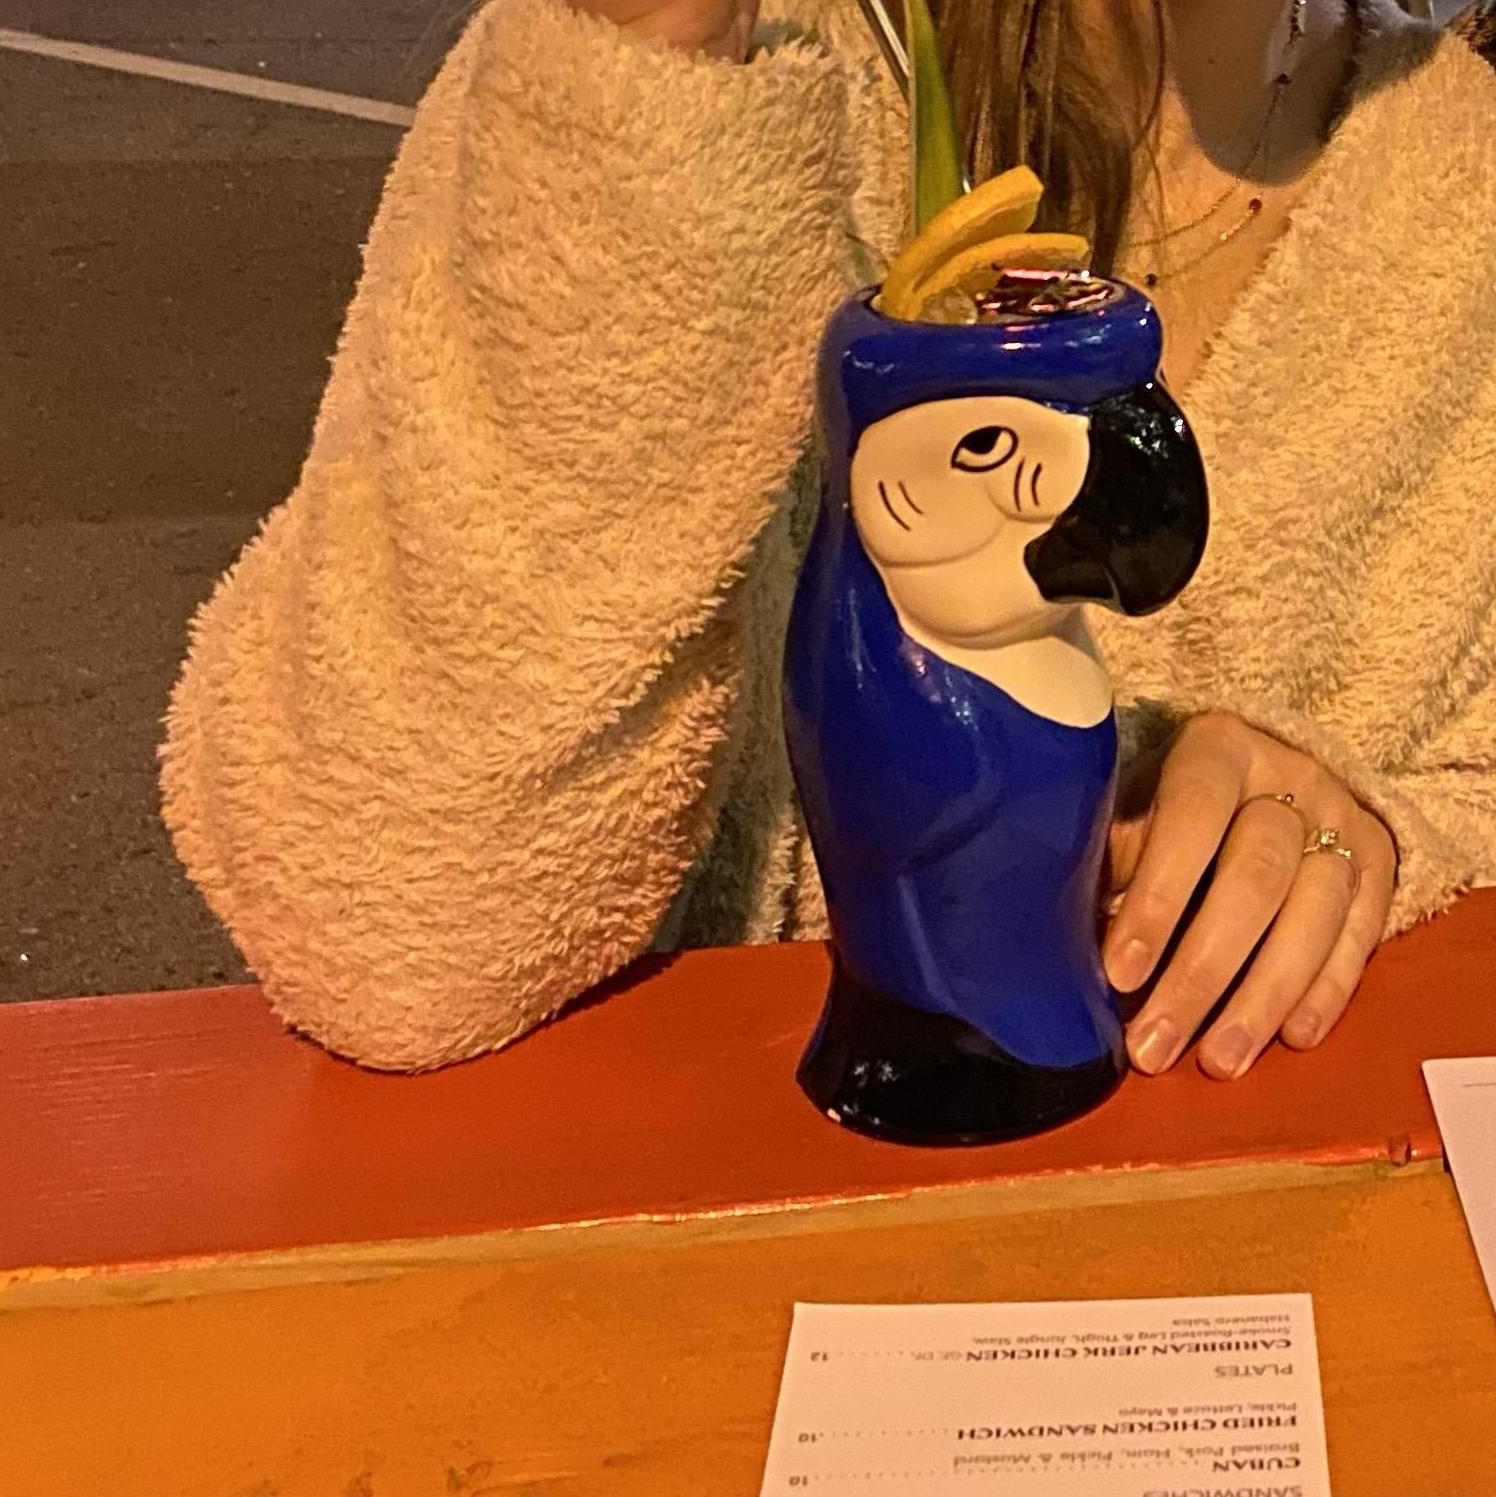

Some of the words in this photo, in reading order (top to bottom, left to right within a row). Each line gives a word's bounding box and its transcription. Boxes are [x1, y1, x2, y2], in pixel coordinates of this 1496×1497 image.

[1172, 1318, 1210, 1328] Salsa
[1215, 1314, 1290, 1326] Habanero
[1071, 1333, 1118, 1344] Thigh,
[1122, 1333, 1135, 1342] &
[1138, 1330, 1166, 1341] Leg
[1170, 1326, 1290, 1340] Smoke-Roasted
[1016, 1334, 1067, 1346] Jungle
[1082, 1344, 1147, 1358] JERK
[1151, 1338, 1292, 1356] CARIBBEAN
[810, 1351, 828, 1362] 12
[965, 1346, 1077, 1362] CHICKEN
[1214, 1363, 1293, 1378] PLATES
[1118, 1406, 1163, 1418] Mayo
[1166, 1406, 1178, 1416] &
[1182, 1404, 1242, 1416] Lettuce
[1247, 1401, 1297, 1412] Pickle,
[1101, 1418, 1217, 1436] CHICKEN
[1222, 1414, 1297, 1431] FRIED
[956, 1423, 1098, 1440] SANDWICH
[1120, 1448, 1171, 1460] Ham,
[1178, 1446, 1224, 1459] Pork,
[1230, 1442, 1300, 1457] Braised
[953, 1454, 1032, 1467] Mustard
[1038, 1452, 1053, 1464] &
[1059, 1450, 1112, 1463] Pickle
[1212, 1456, 1301, 1473] CUBAN
[788, 1474, 808, 1487] 10
[1142, 1485, 1303, 1497] SANDWICHES
